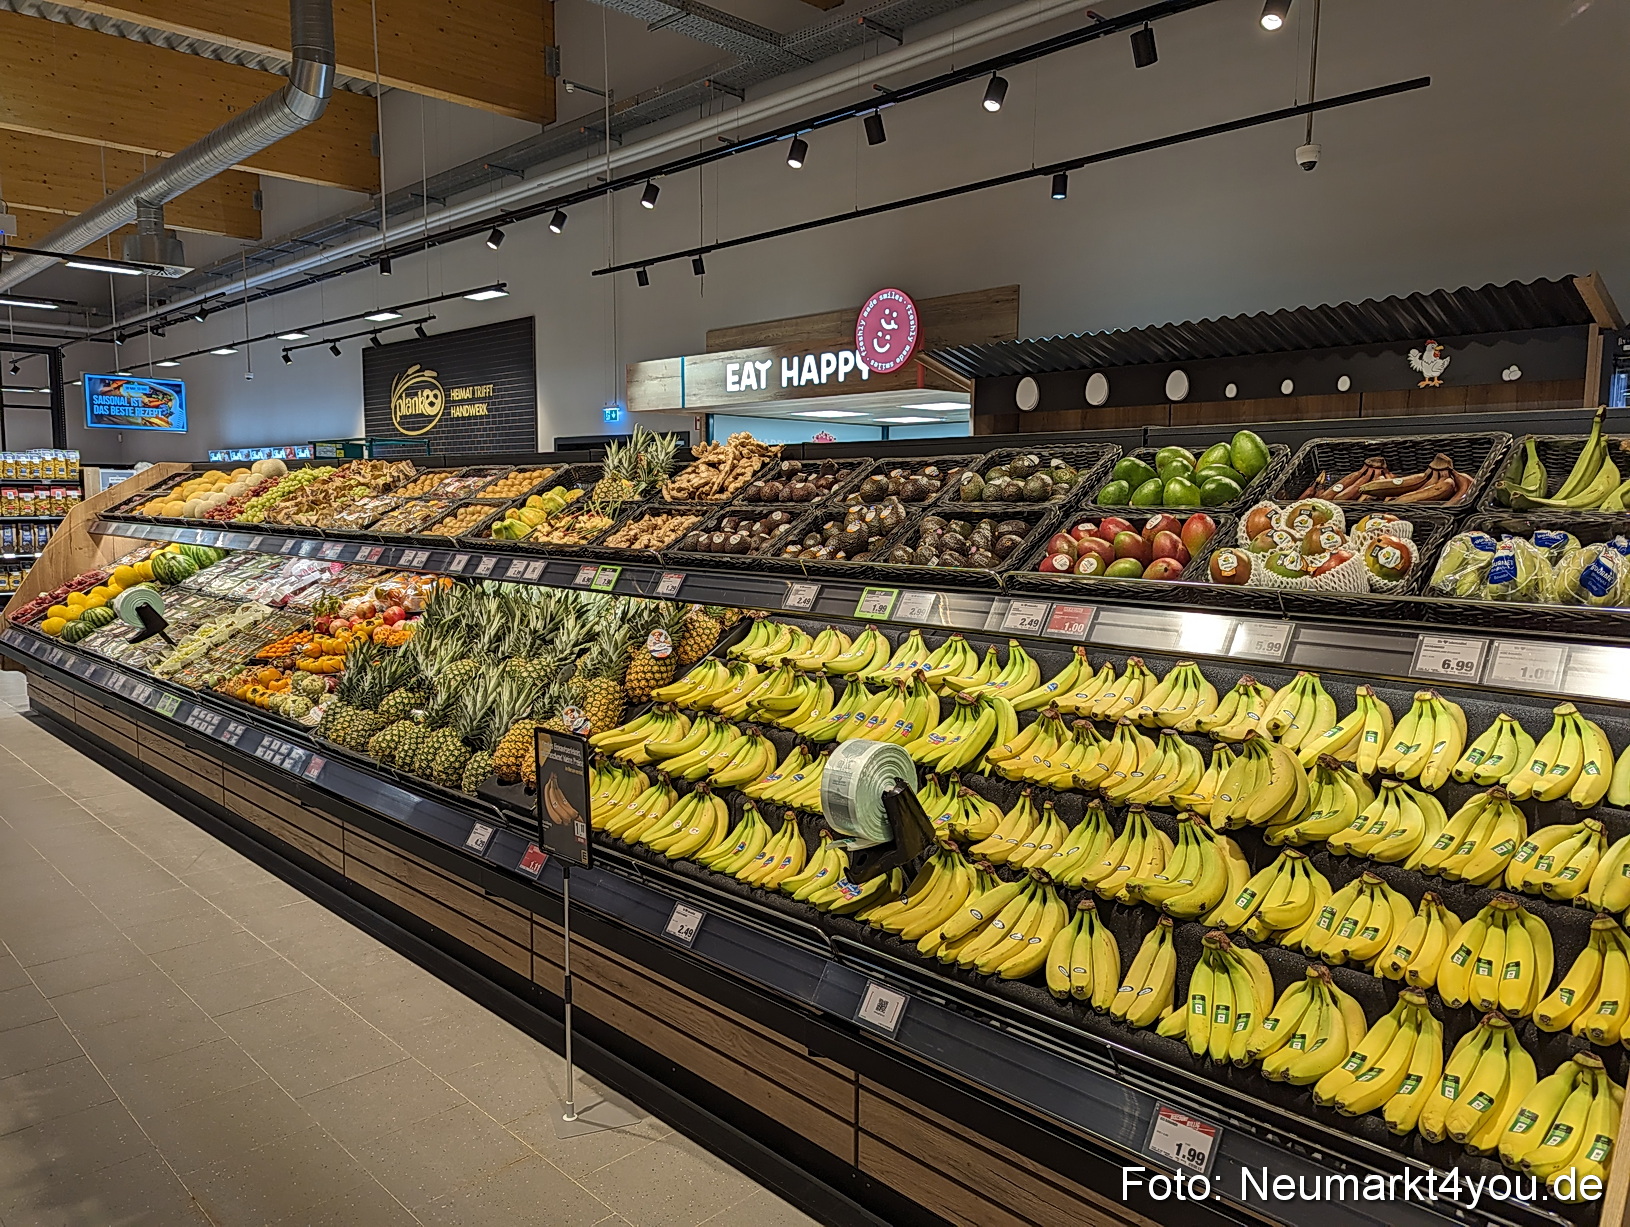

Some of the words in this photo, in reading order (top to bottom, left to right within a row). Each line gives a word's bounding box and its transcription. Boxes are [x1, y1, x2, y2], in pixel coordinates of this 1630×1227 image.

[726, 359, 773, 392] EAT
[781, 350, 870, 388] HAPPY
[450, 386, 473, 401] HEIMAT
[474, 384, 494, 398] TRIFFT
[92, 394, 129, 407] SAISONAL
[130, 397, 143, 407] IST
[93, 405, 109, 415] DAS
[110, 406, 134, 416] BESTE
[135, 408, 163, 418] REZEPT
[450, 403, 489, 418] HANDWERK
[797, 597, 811, 606] 2.49
[872, 603, 887, 613] 1.99
[1019, 617, 1040, 628] 2.49
[1064, 621, 1085, 633] 1.00
[1255, 641, 1282, 652] 5.99
[1441, 659, 1475, 673] 6.99
[677, 924, 694, 938] 2.49
[1175, 1142, 1206, 1167] 1.99
